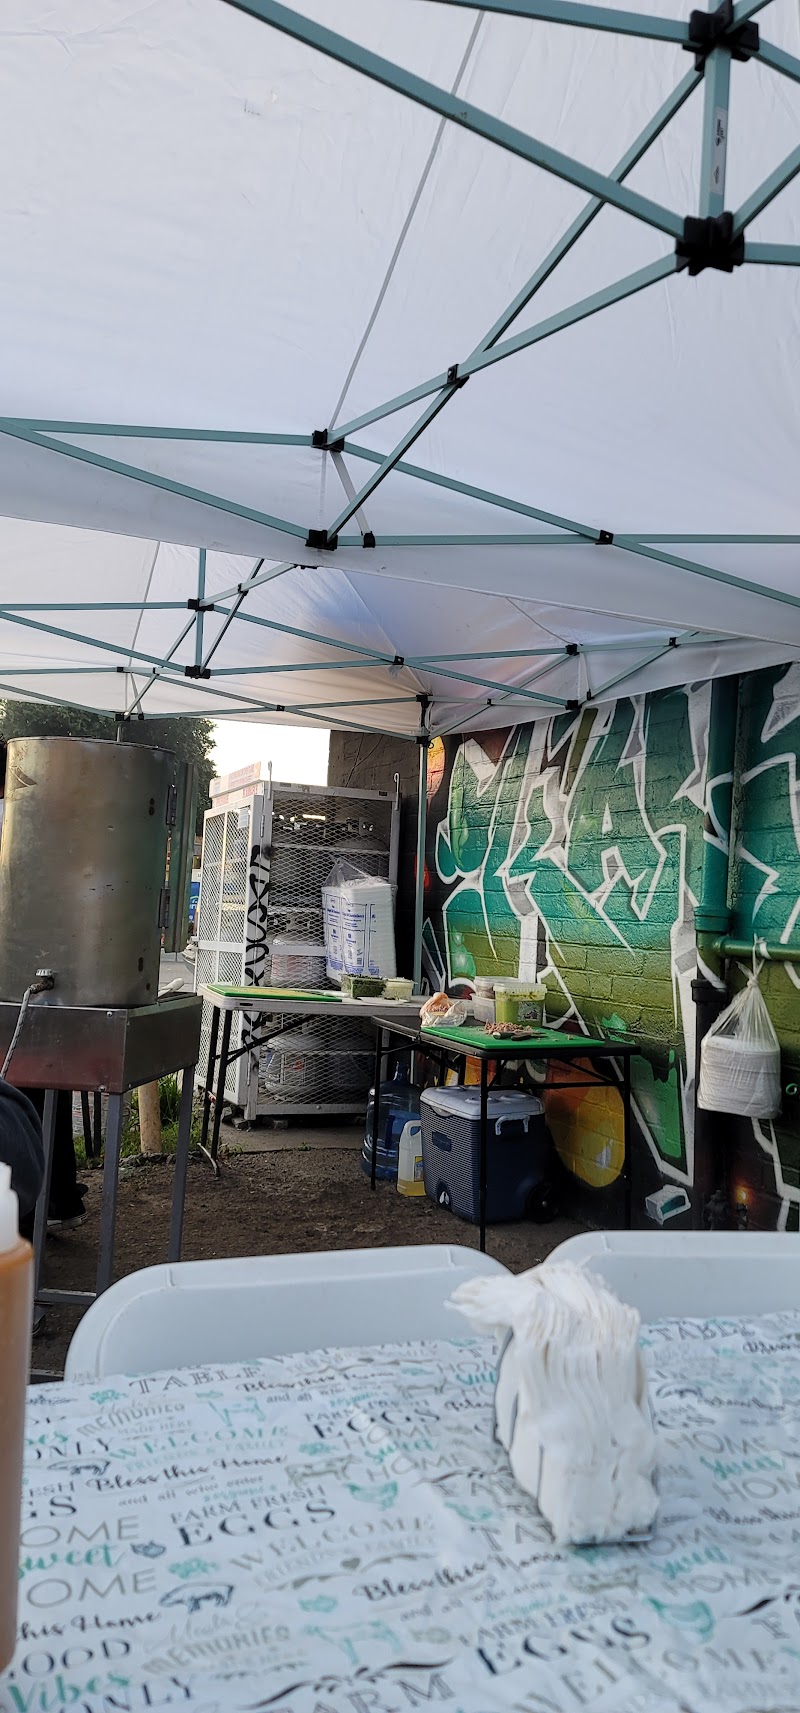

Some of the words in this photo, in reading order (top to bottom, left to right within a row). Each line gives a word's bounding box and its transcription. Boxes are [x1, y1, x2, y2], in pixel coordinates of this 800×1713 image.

[107, 1425, 288, 1460] WELCOME
[20, 1515, 140, 1548] OME
[178, 1500, 335, 1546] EGGS
[27, 1566, 158, 1609] OME
